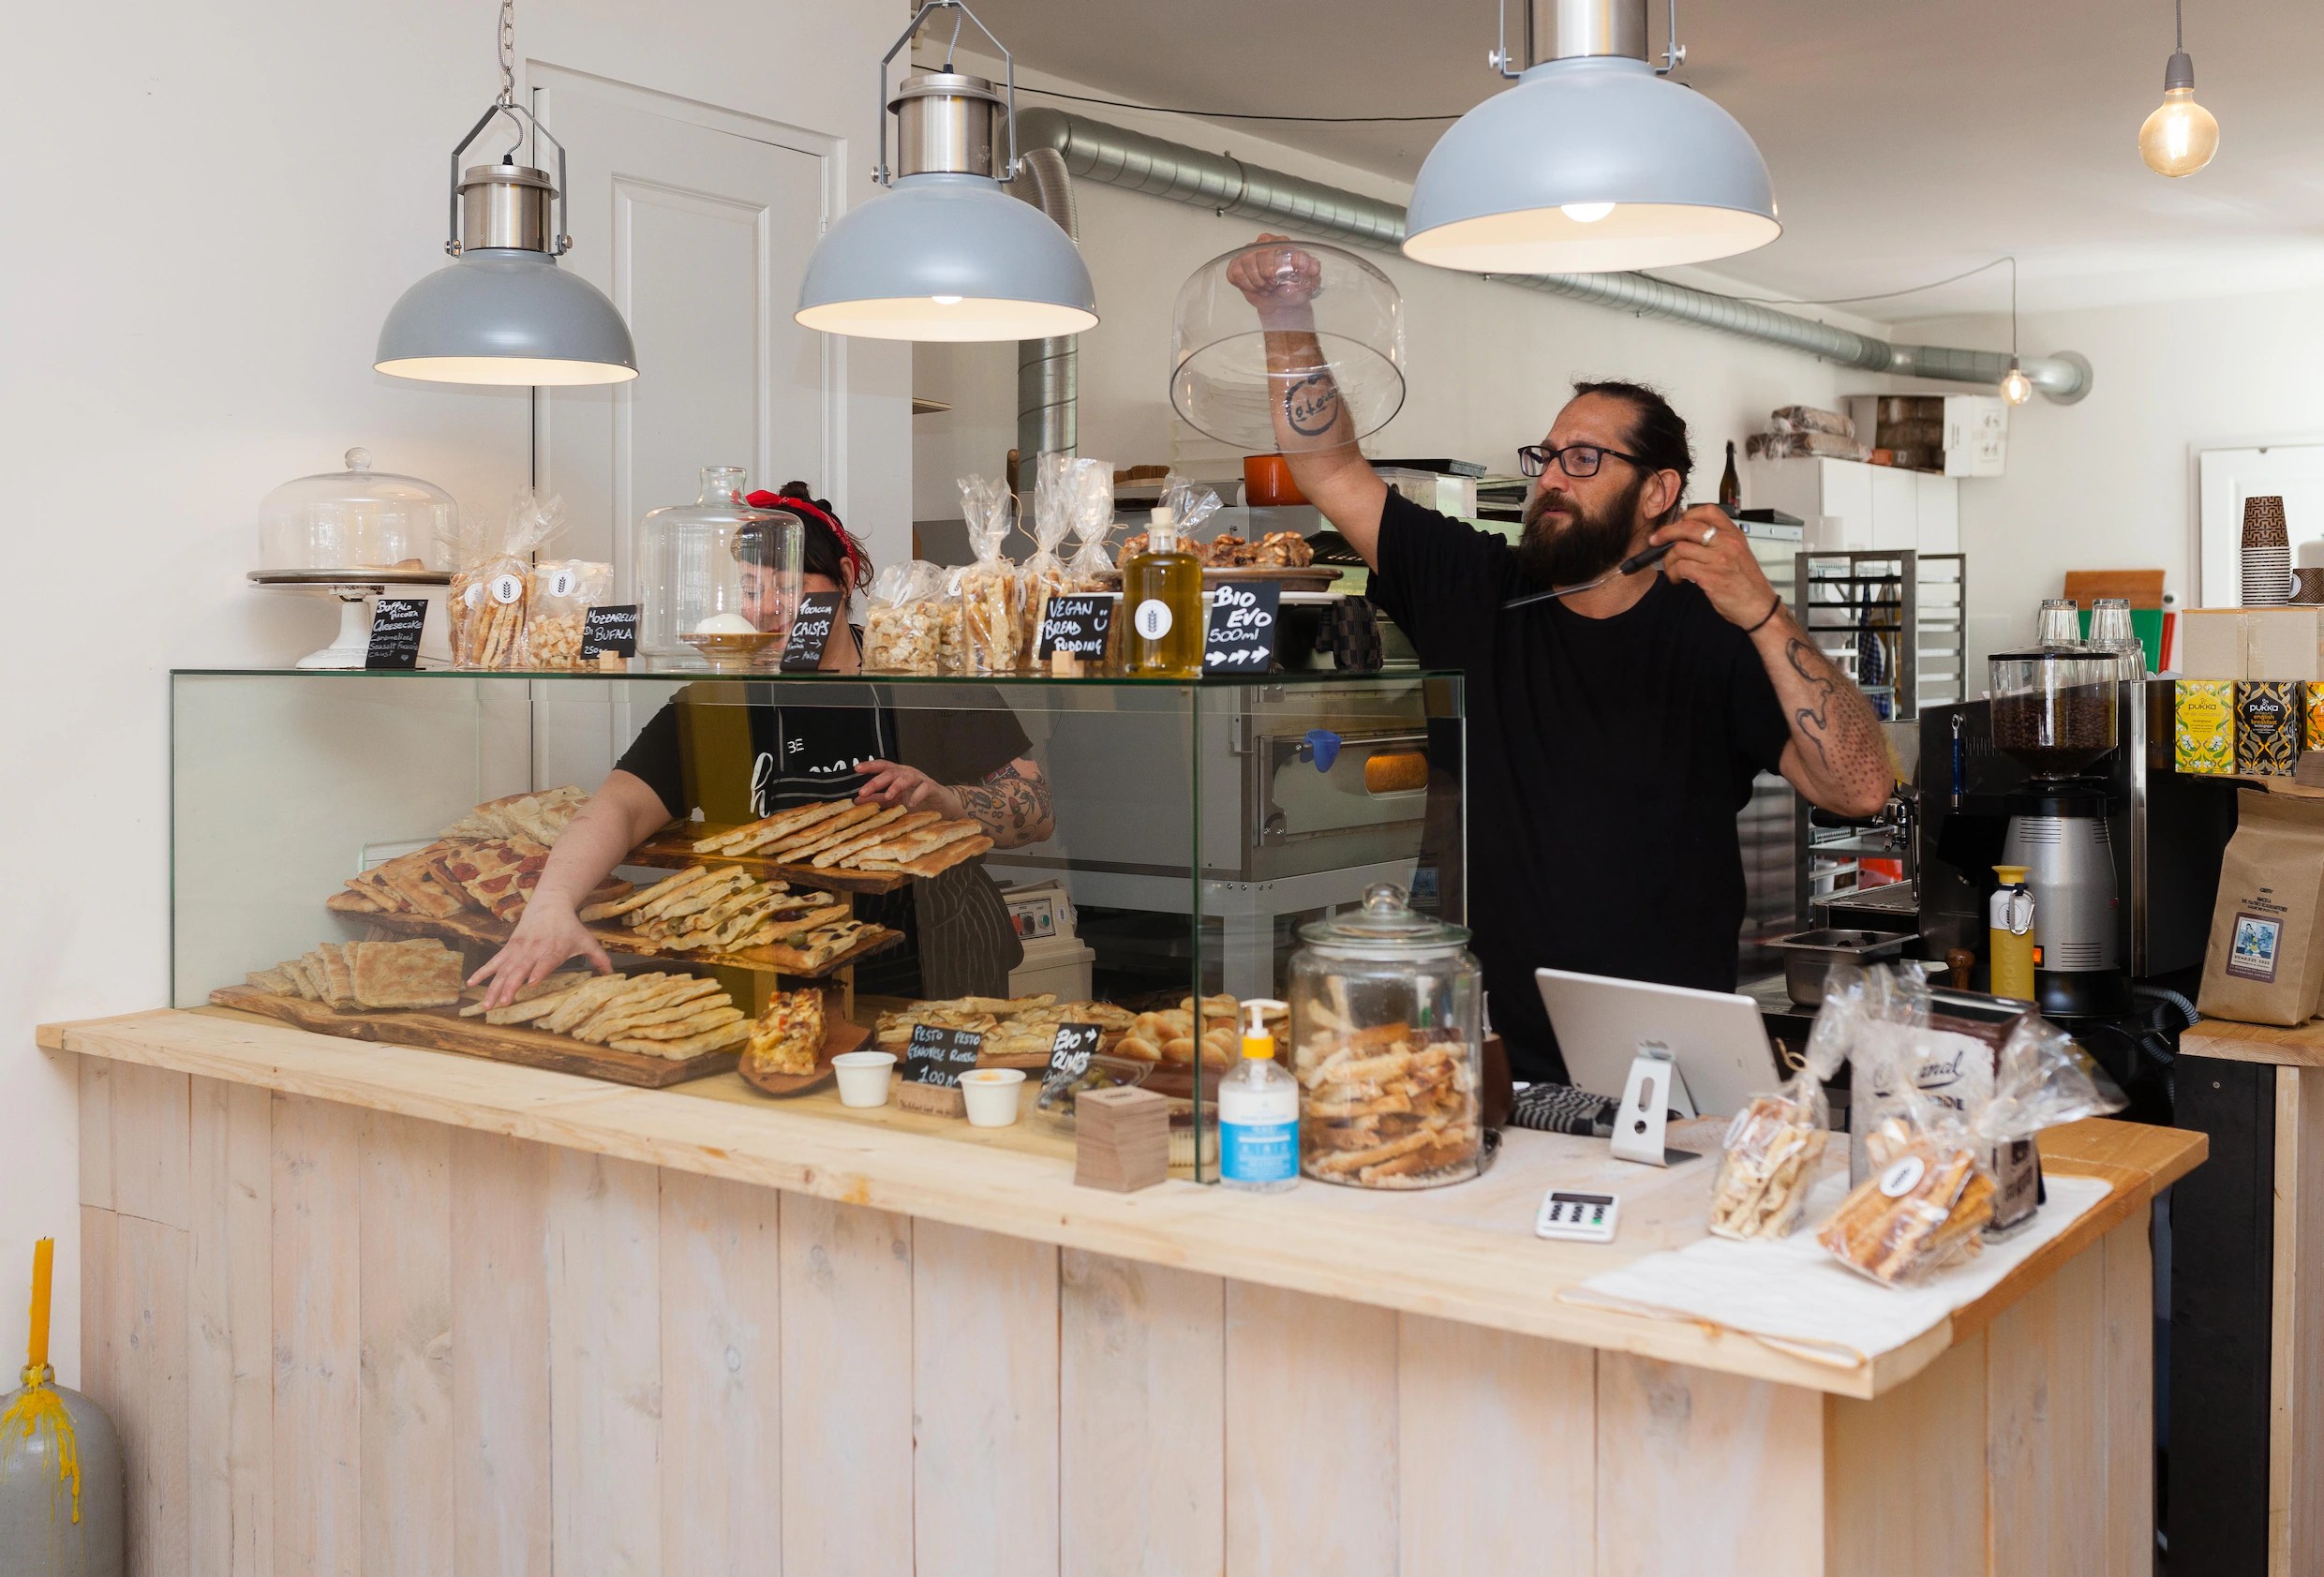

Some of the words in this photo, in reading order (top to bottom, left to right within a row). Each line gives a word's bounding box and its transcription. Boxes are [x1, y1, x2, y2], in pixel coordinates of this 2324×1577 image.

[1212, 585, 1256, 607] BIO
[1050, 597, 1094, 618] VEGAN
[1226, 607, 1273, 628] EVO
[594, 626, 633, 641] BUFALA
[792, 620, 830, 637] CRISPS
[1044, 618, 1081, 640] BREAD
[1208, 628, 1259, 643] 500ml
[1053, 637, 1102, 655] PUDDING
[915, 1025, 943, 1042] PESTO
[954, 1031, 980, 1046] PESTO
[1053, 1029, 1081, 1051] BIO
[907, 1042, 946, 1062] GENOVESE
